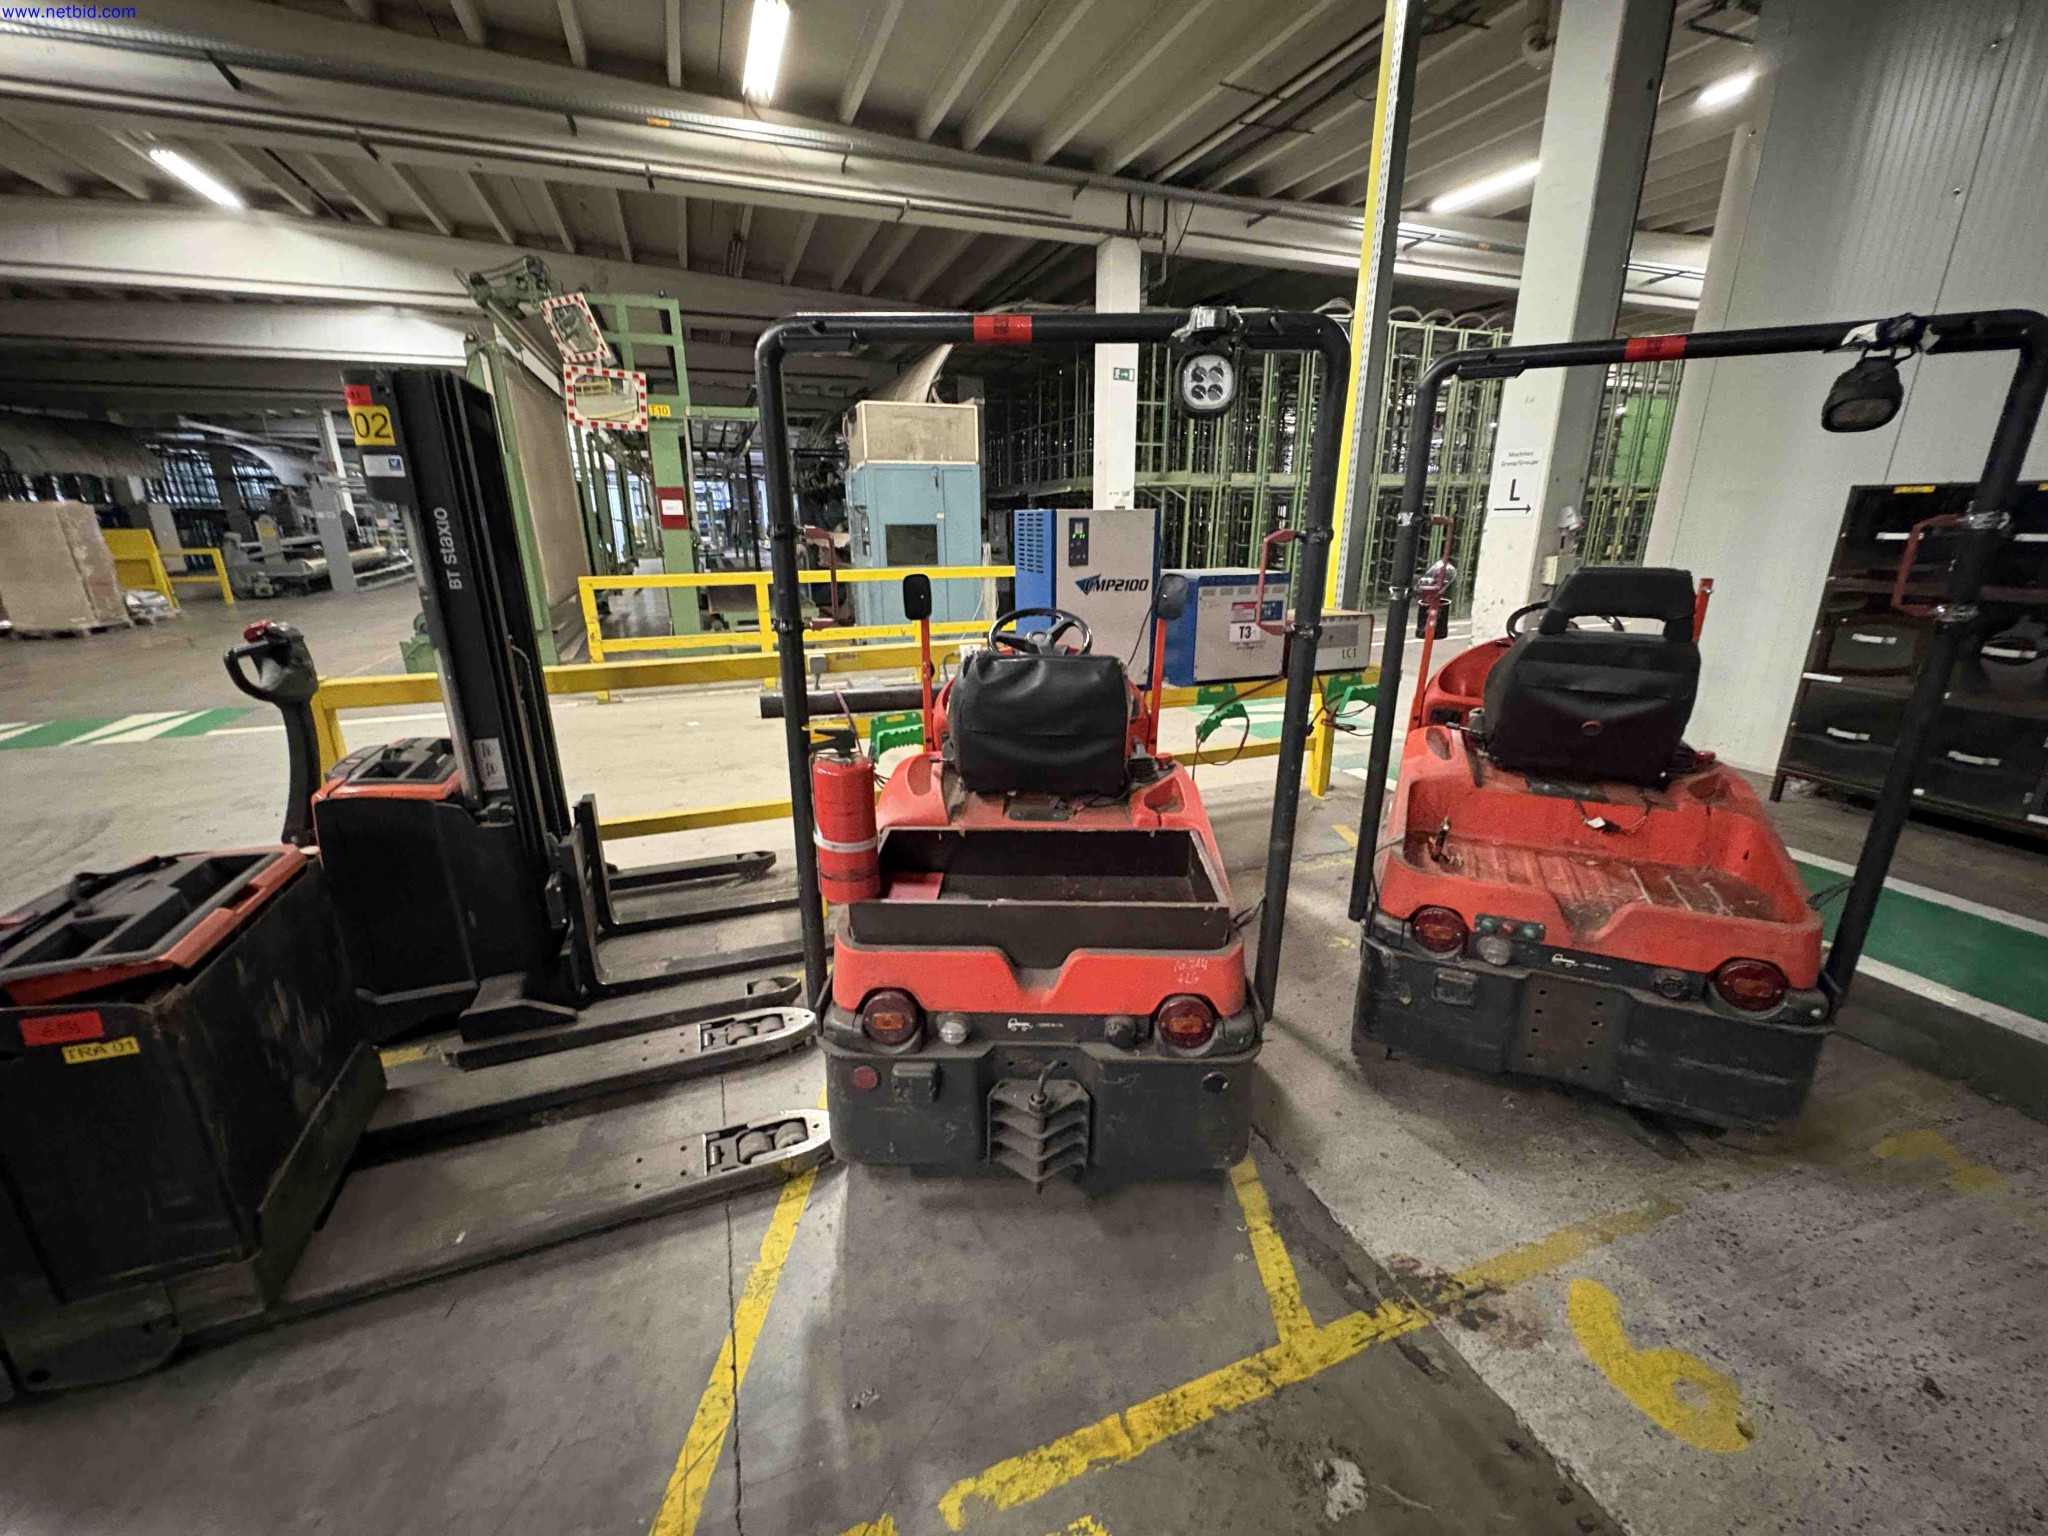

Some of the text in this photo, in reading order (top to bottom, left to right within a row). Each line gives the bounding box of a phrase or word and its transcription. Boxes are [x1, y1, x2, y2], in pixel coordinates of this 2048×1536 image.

[354, 412, 392, 438] 02
[1509, 479, 1520, 501] L
[446, 569, 462, 590] BT
[1239, 626, 1252, 639] T3
[67, 1046, 107, 1060] TRA
